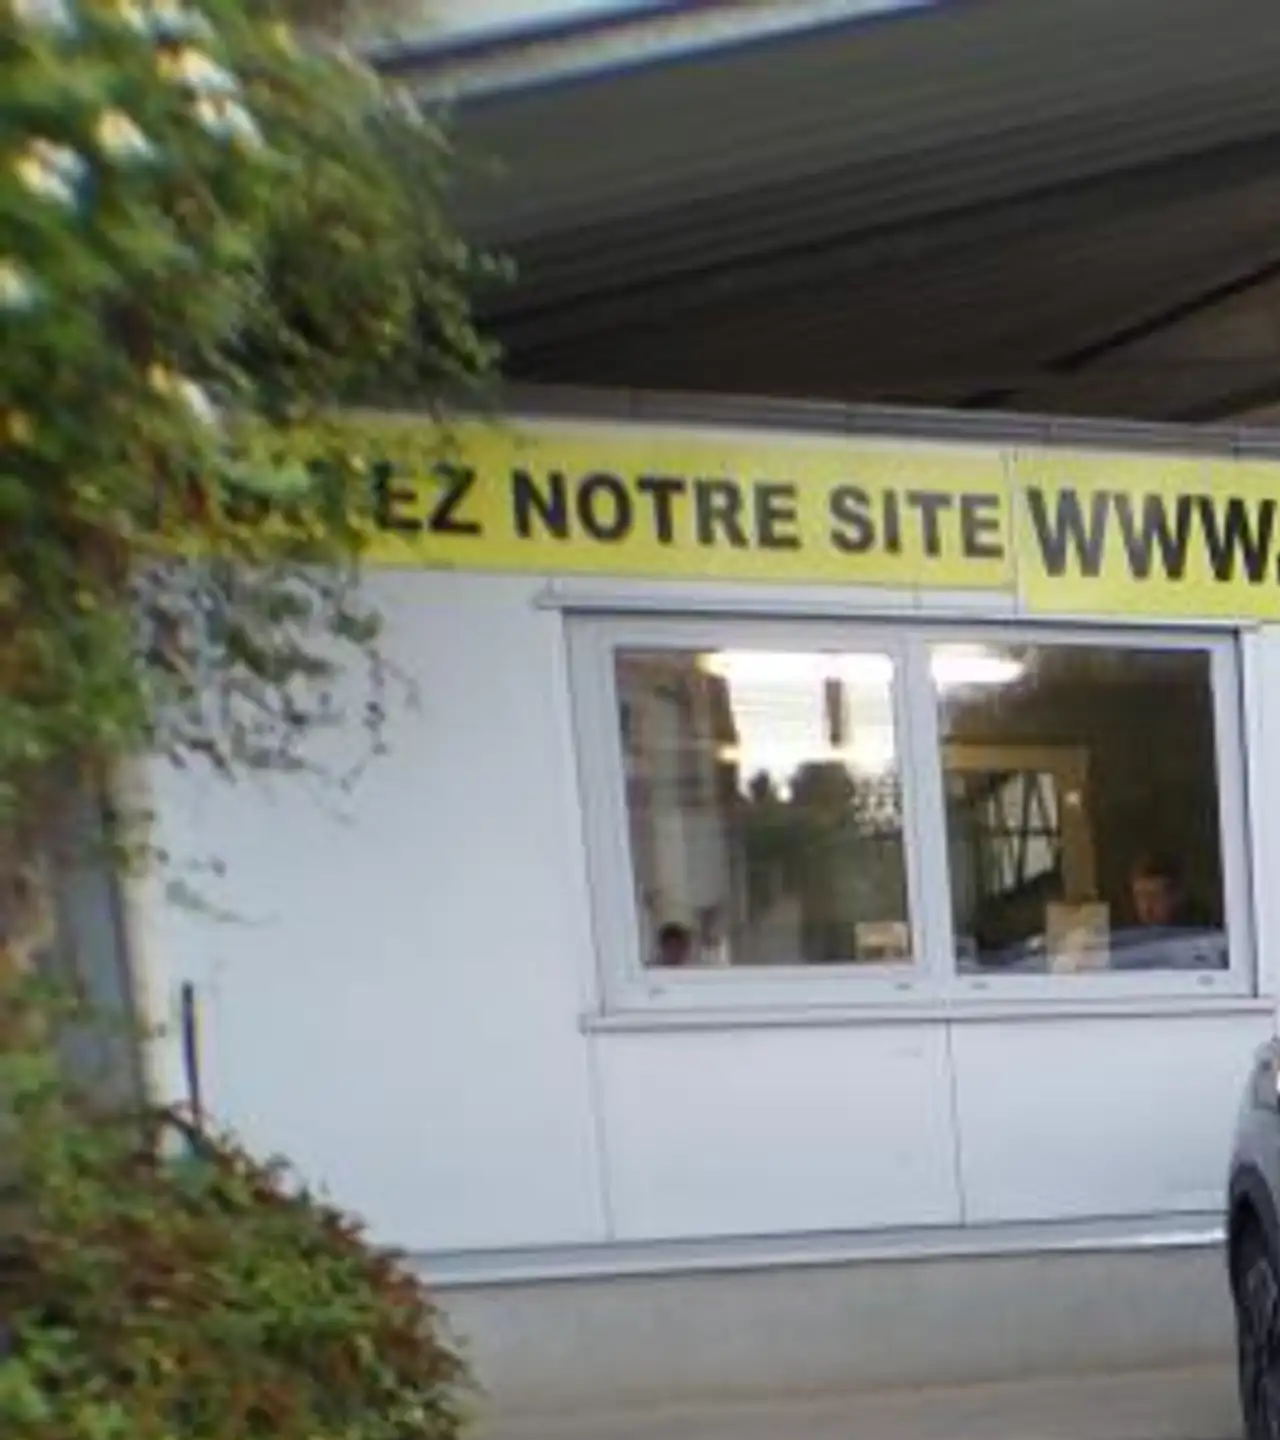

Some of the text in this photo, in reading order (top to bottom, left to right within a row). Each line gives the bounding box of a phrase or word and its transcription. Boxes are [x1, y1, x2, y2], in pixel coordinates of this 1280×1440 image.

[370, 460, 1006, 559] EZ NOTRE SITE
